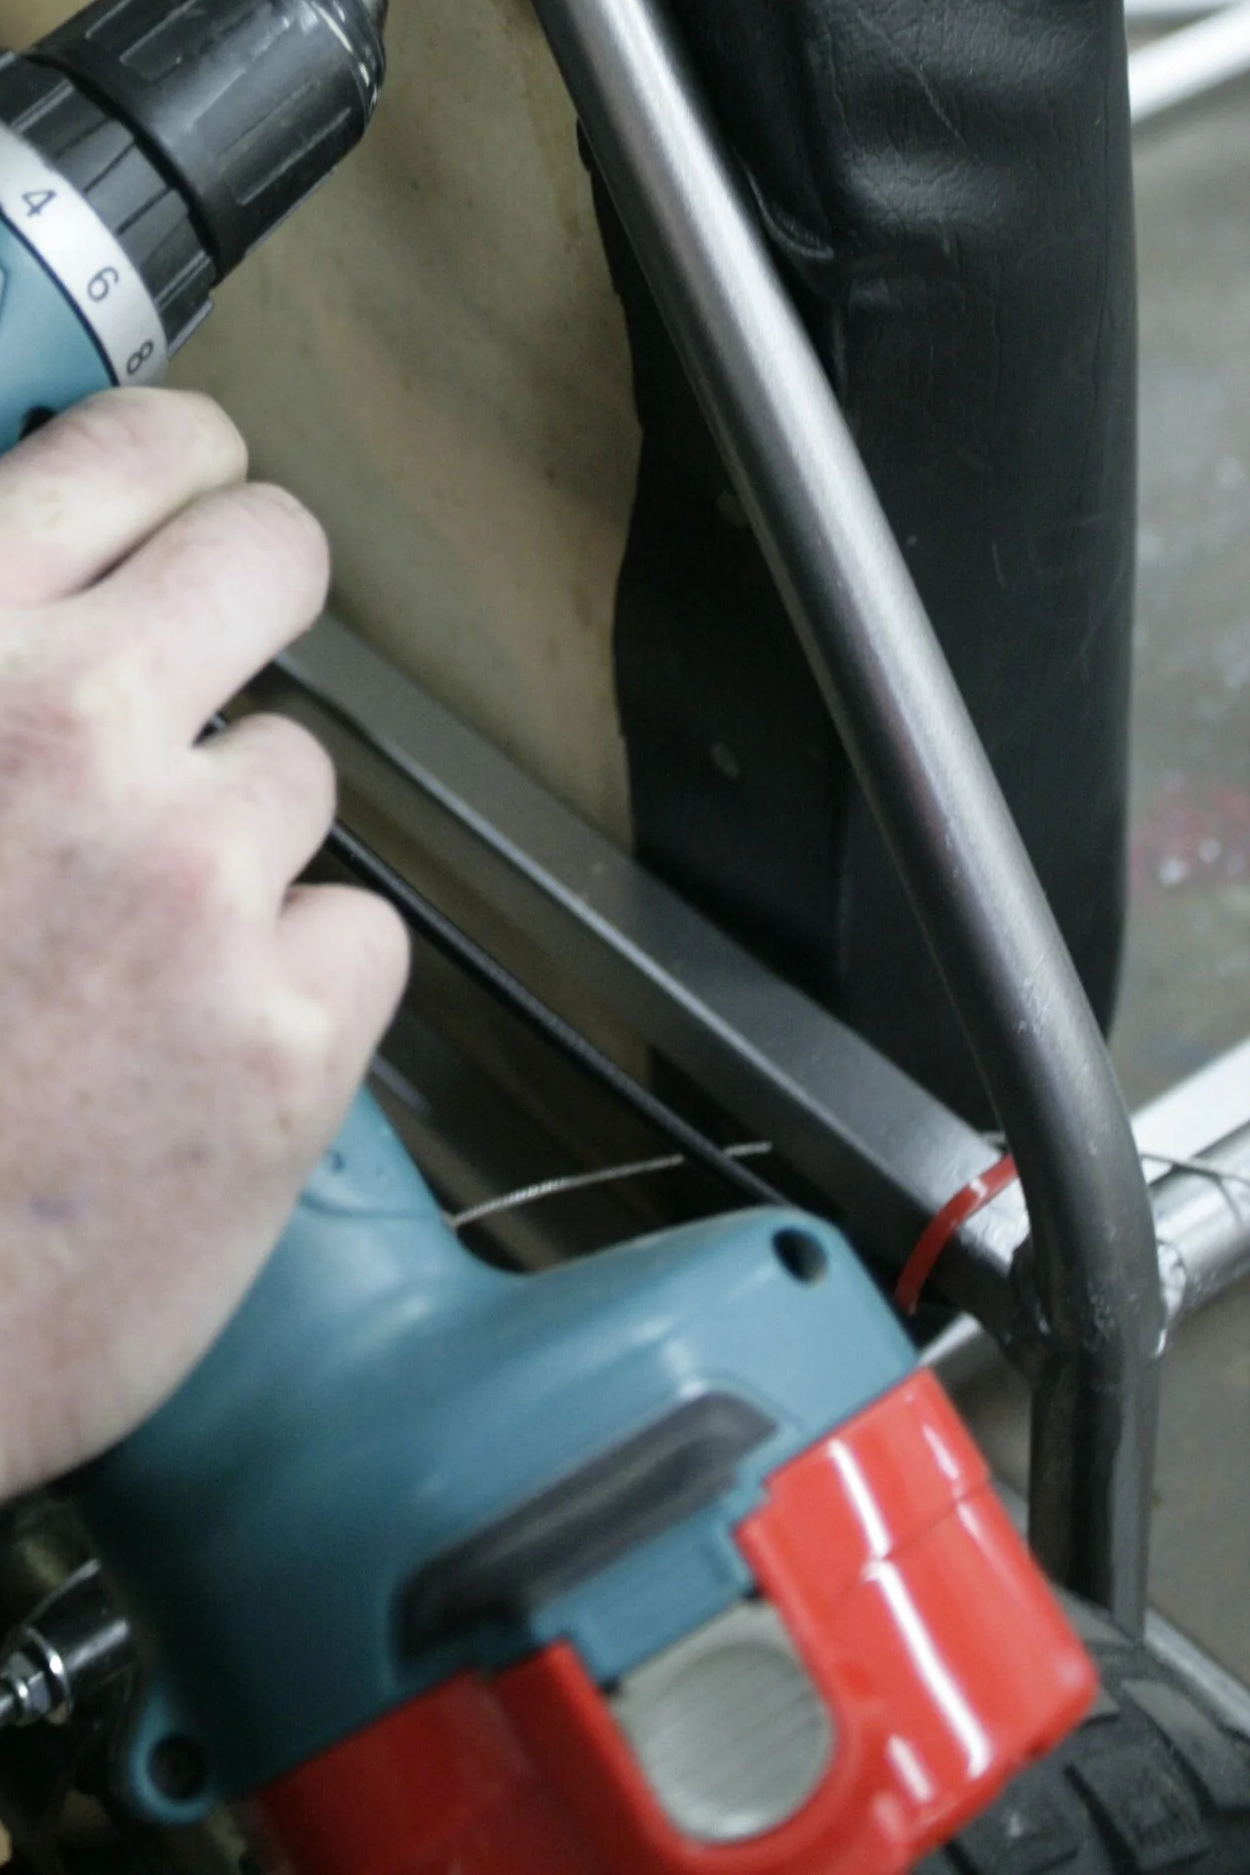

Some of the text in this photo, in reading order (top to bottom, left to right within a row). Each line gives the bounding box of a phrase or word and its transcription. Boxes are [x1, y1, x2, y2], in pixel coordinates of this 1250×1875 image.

[22, 189, 57, 217] 4
[87, 266, 119, 303] 6
[126, 341, 154, 376] 8
